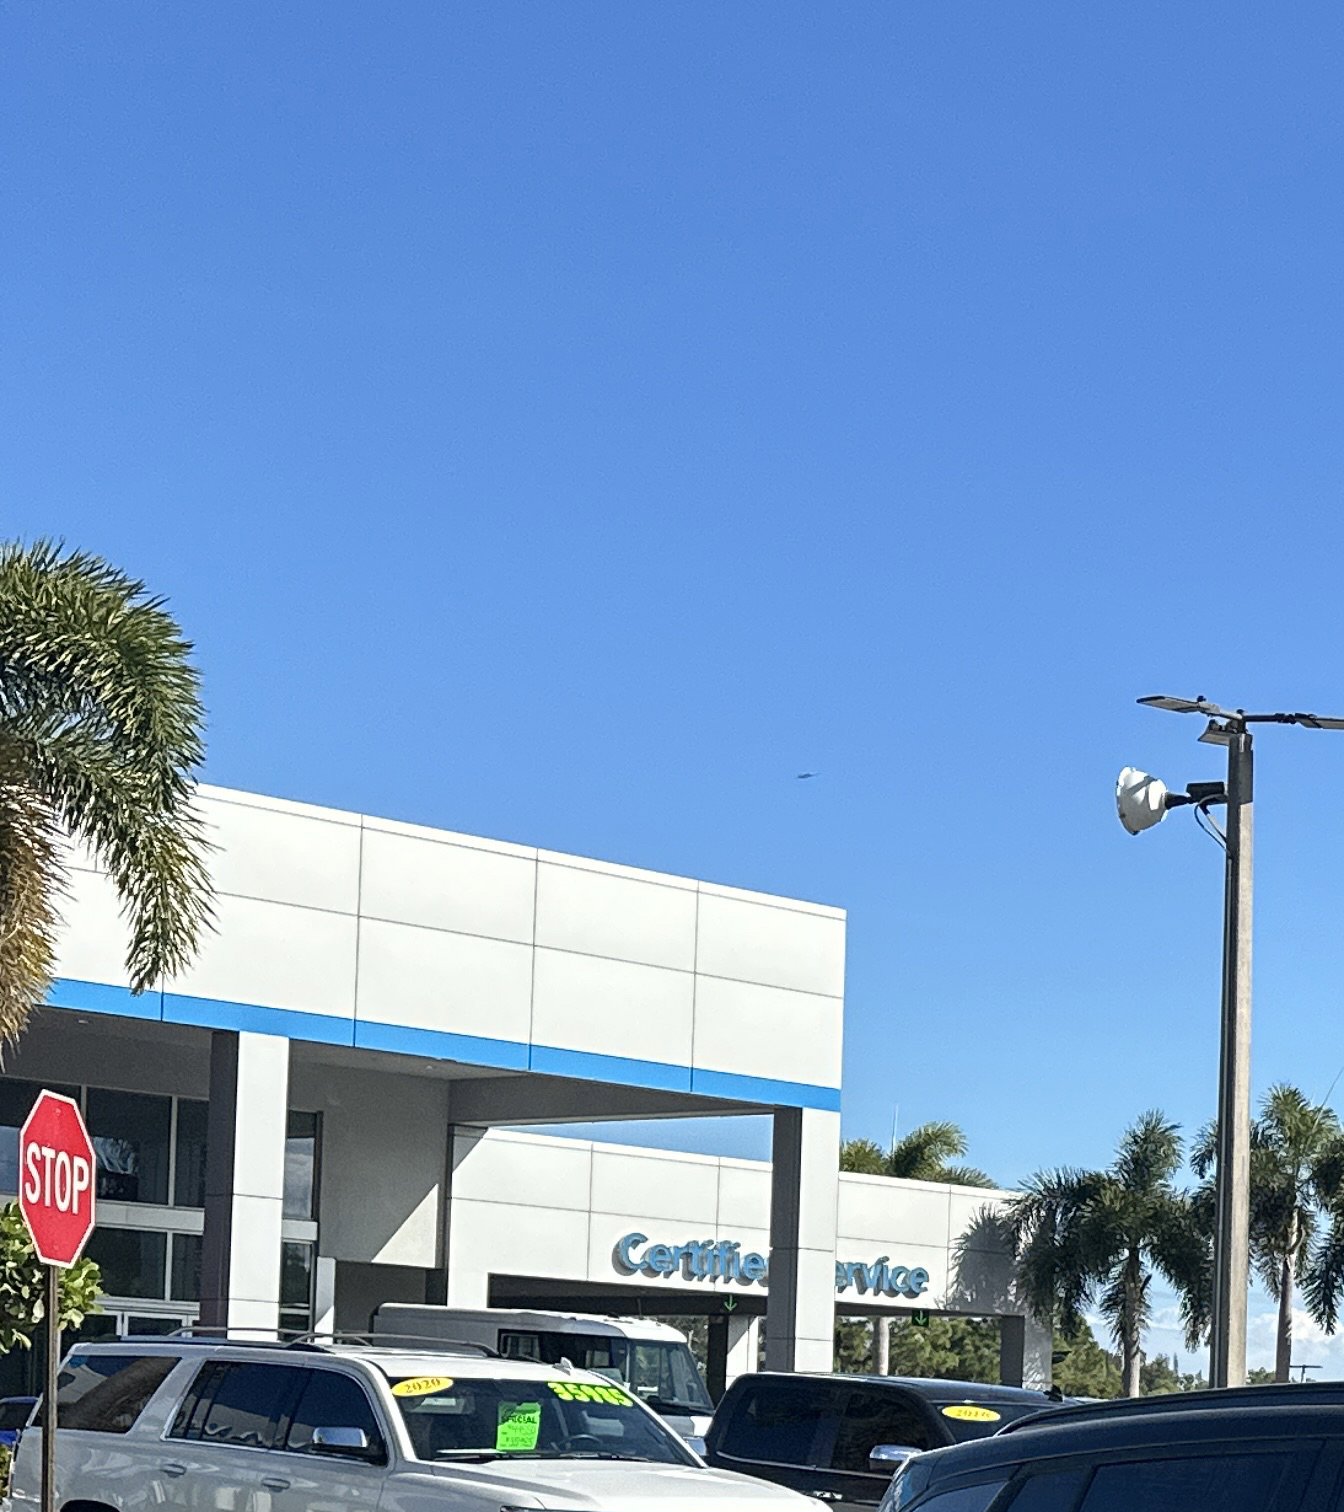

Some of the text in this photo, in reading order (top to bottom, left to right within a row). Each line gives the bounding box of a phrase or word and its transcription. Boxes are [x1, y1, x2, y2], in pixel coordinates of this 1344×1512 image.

[25, 1142, 90, 1215] STOP
[613, 1232, 930, 1295] Certifie ervice
